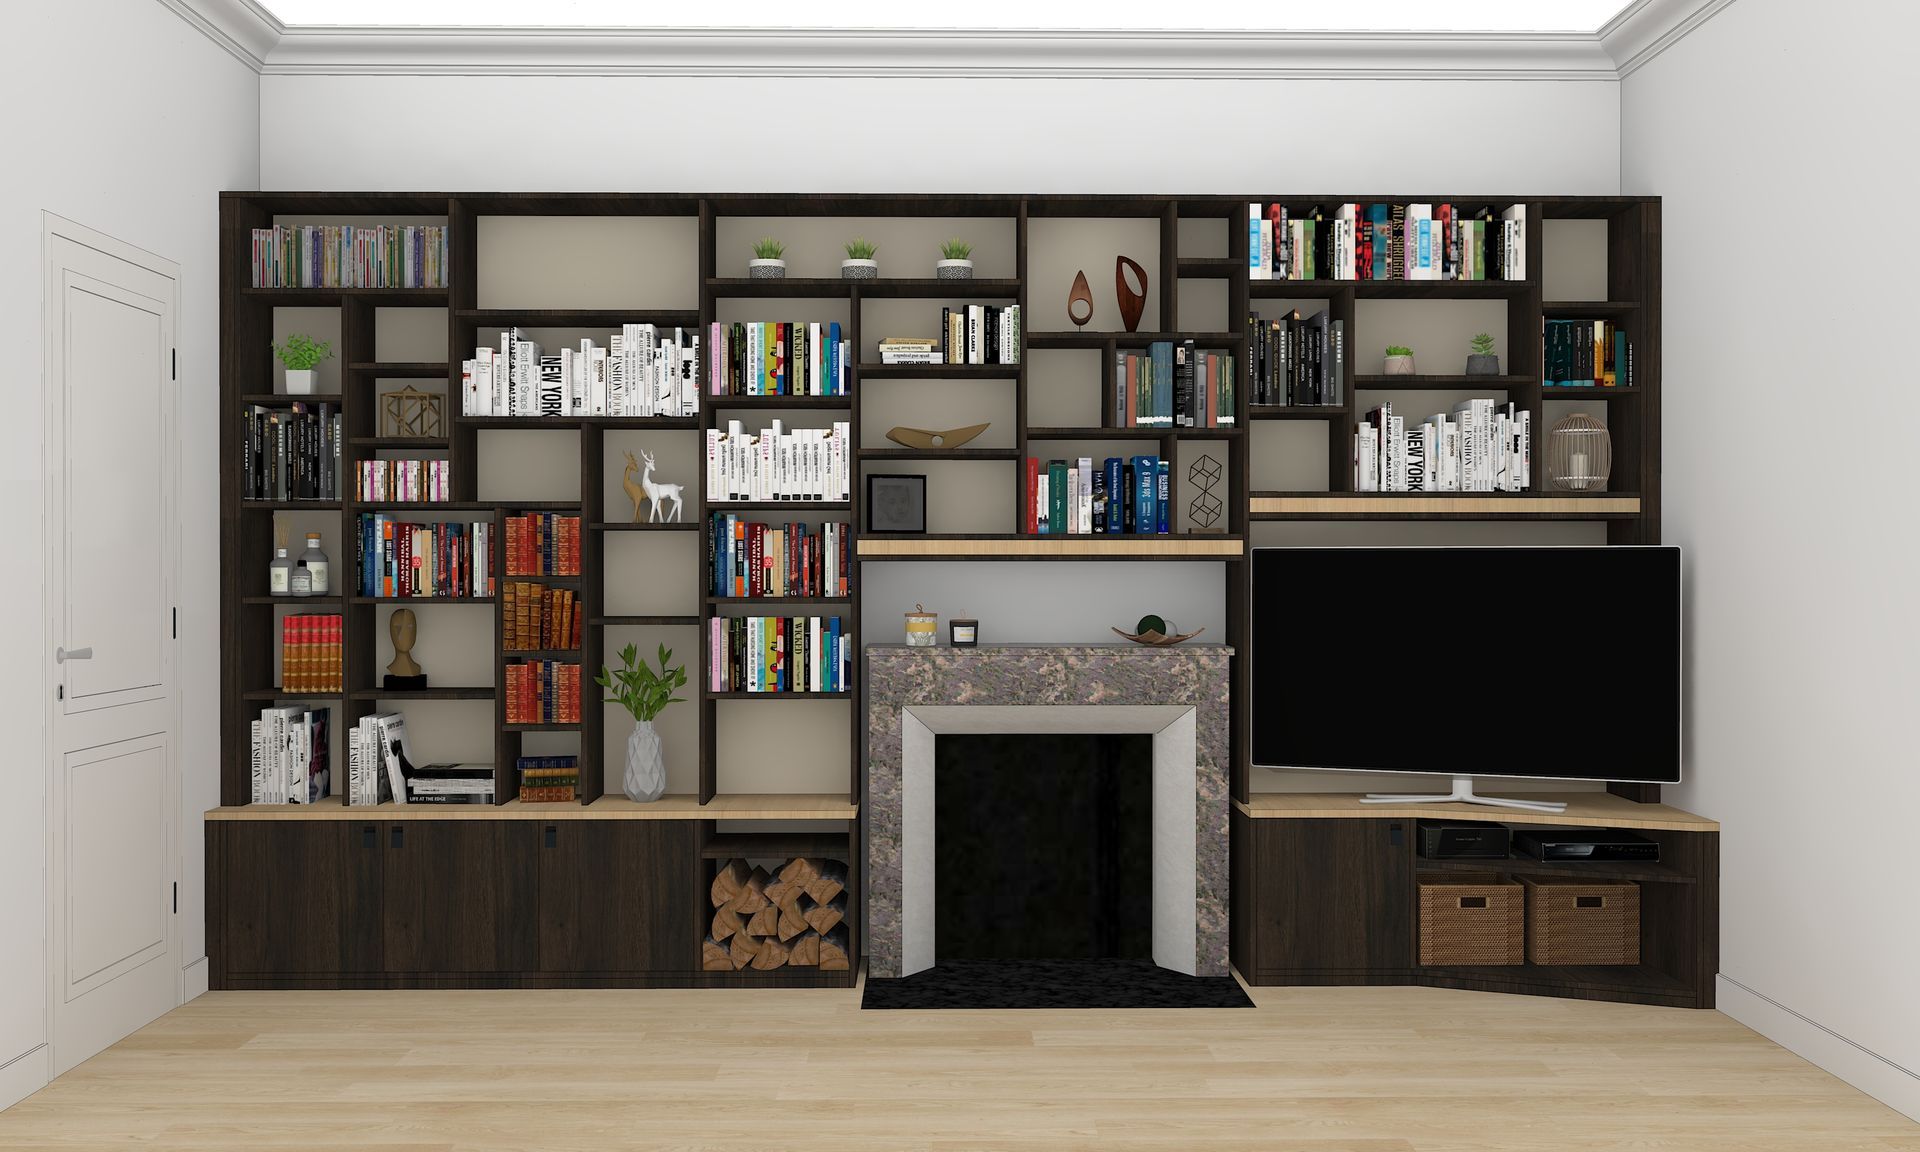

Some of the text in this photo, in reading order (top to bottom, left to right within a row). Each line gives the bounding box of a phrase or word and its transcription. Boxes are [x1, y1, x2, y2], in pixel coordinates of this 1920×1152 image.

[1392, 205, 1404, 230] ATLAS
[794, 328, 802, 360] WICKED
[519, 343, 530, 409] Elliott Erwitt Snaps
[541, 357, 562, 416] NEW YORK
[612, 337, 623, 416] THE FASHION BOOK
[1393, 418, 1401, 484] Elliott Erwitt Snaps
[1407, 432, 1424, 491] NEW YORK
[1464, 412, 1472, 491] THE FASHION BOOK
[1095, 472, 1103, 494] HALO
[1141, 476, 1151, 487] Max
[1141, 488, 1151, 498] 3ds
[1161, 474, 1169, 500] BUSINESS
[794, 622, 803, 655] WICKED
[253, 723, 261, 803] THE FASHION BOOK
[350, 729, 359, 804] THE FASHION BOOK
